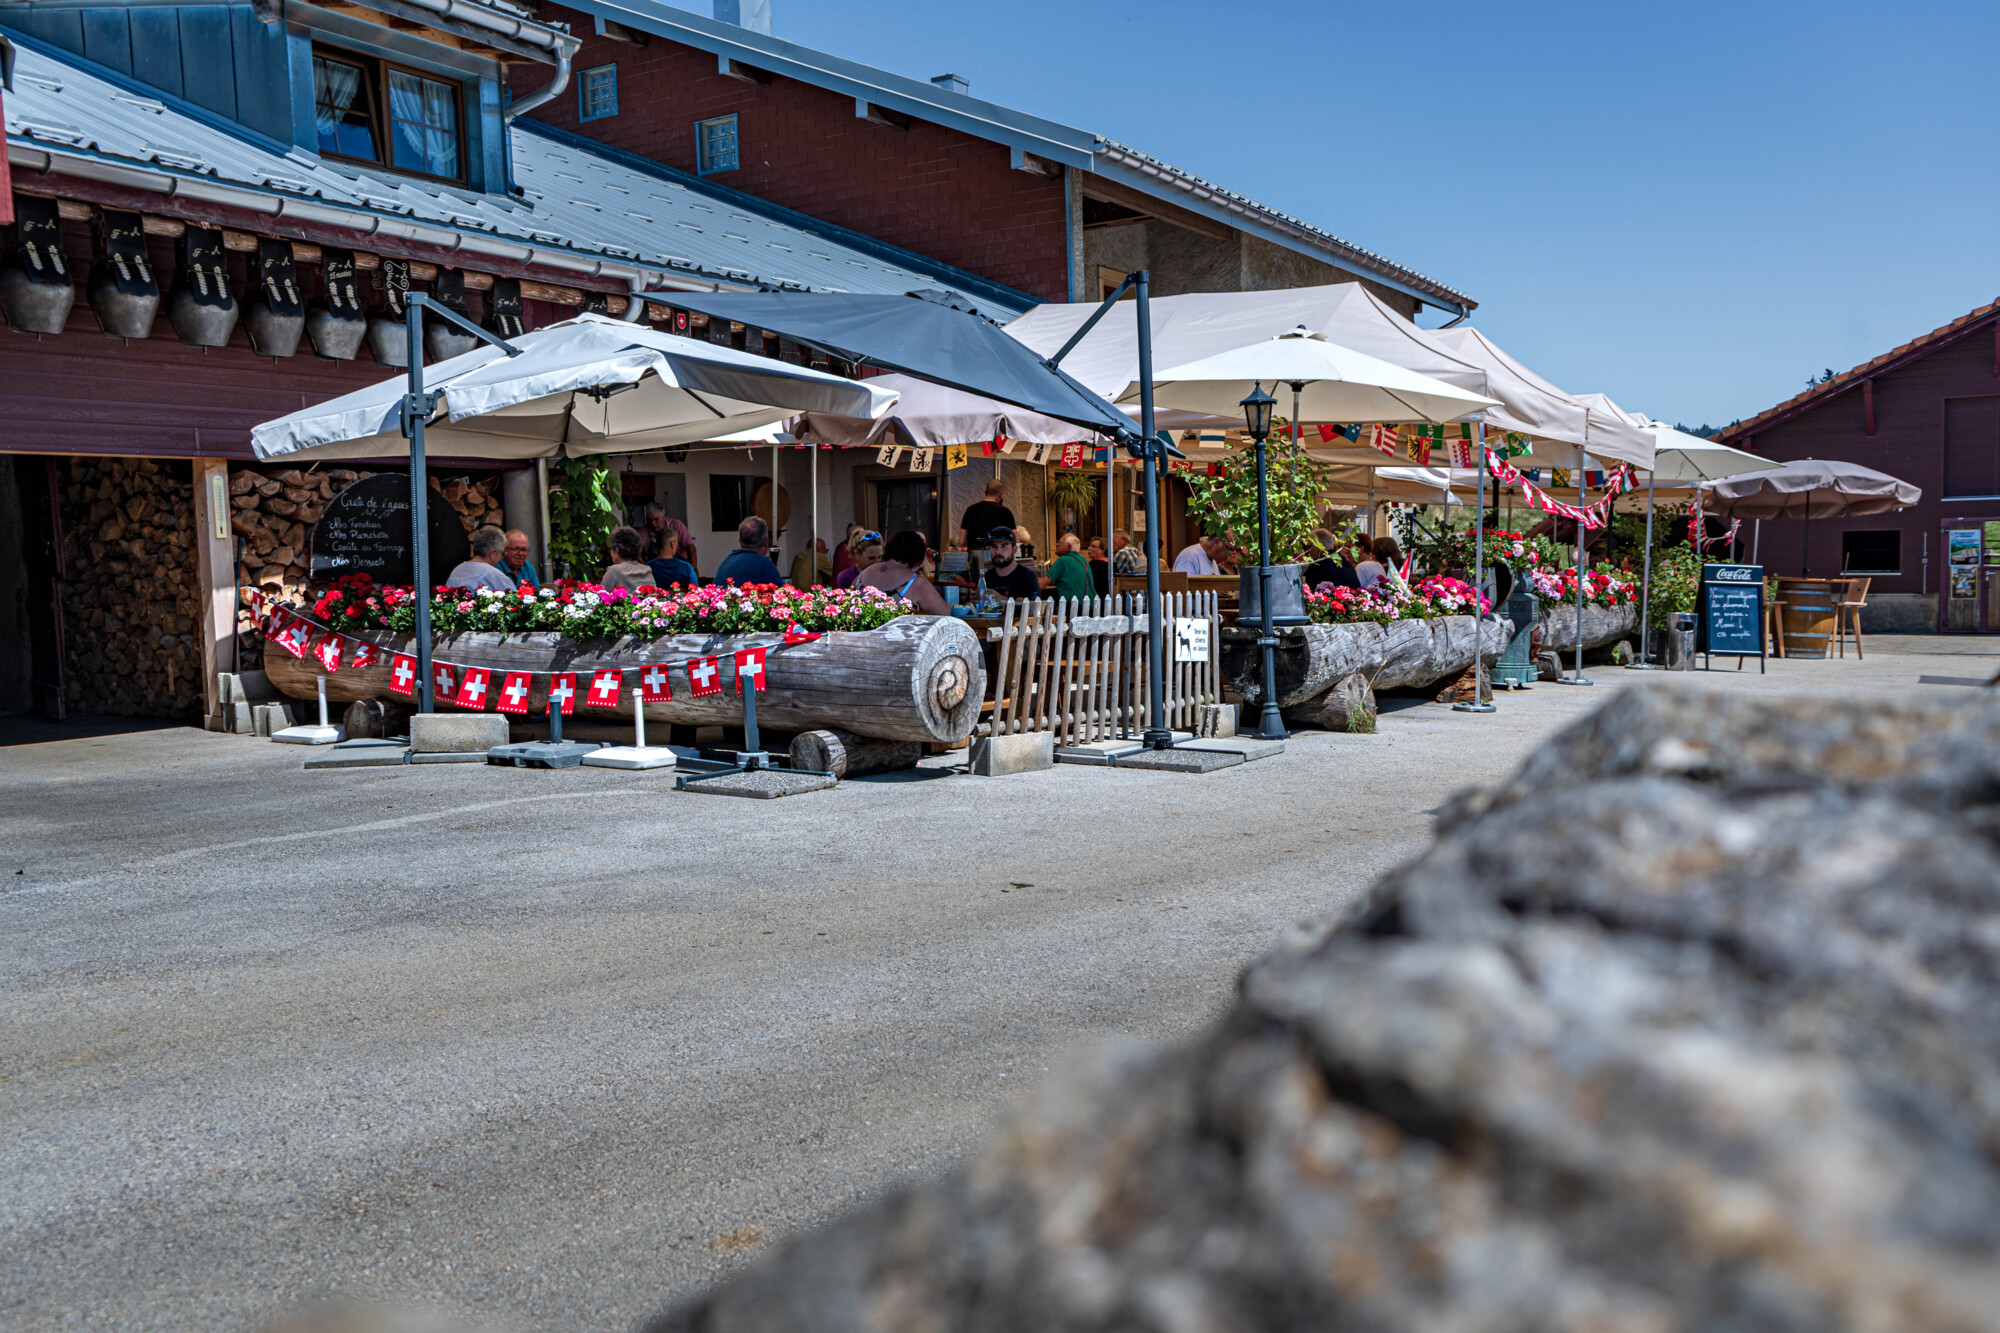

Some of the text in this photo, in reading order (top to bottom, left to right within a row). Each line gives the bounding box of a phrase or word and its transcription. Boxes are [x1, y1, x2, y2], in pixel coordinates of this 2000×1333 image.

[340, 493, 365, 508] Carte
[367, 496, 378, 508] de
[331, 555, 350, 568] Nos
